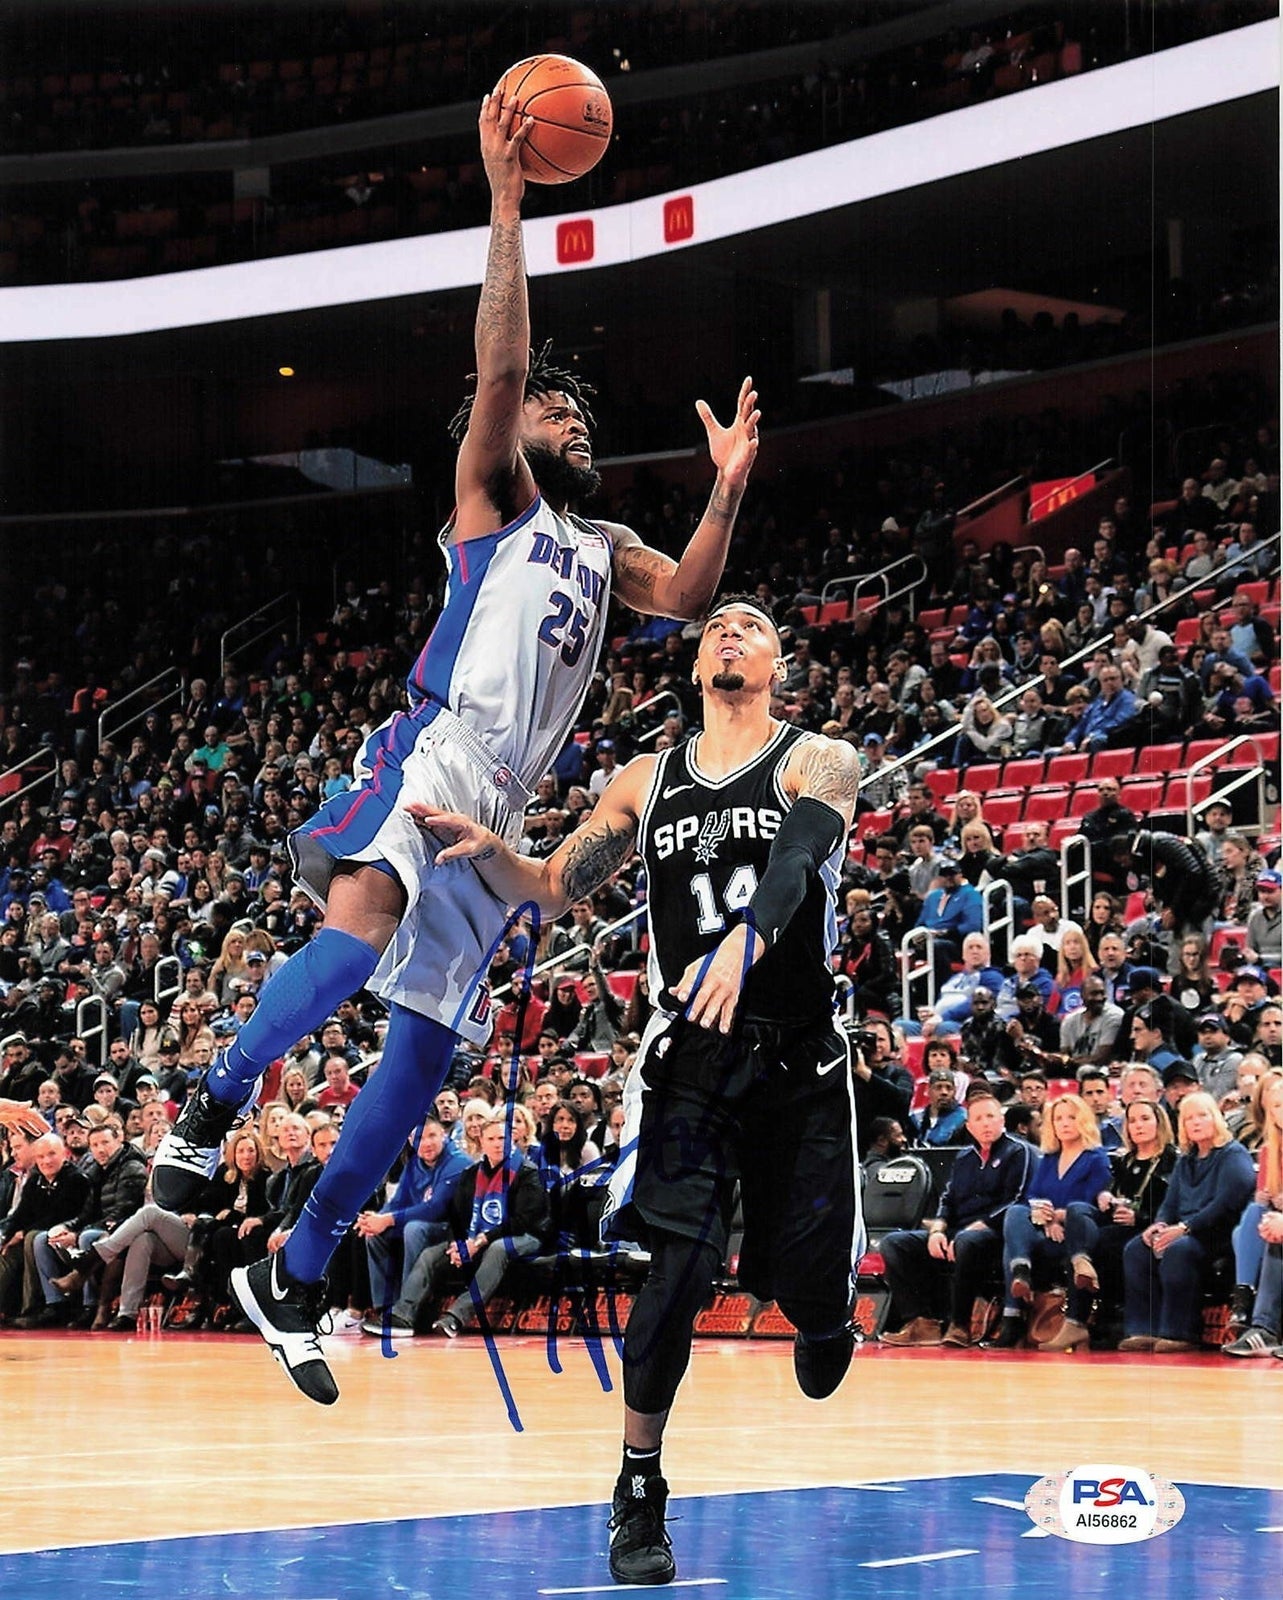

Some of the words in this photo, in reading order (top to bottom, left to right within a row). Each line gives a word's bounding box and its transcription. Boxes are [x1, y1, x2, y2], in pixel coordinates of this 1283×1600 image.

[527, 531, 606, 607] DETOI
[538, 590, 590, 668] 25
[653, 806, 782, 866] SPURS
[690, 864, 759, 935] 14
[694, 1311, 751, 1332] Caesars
